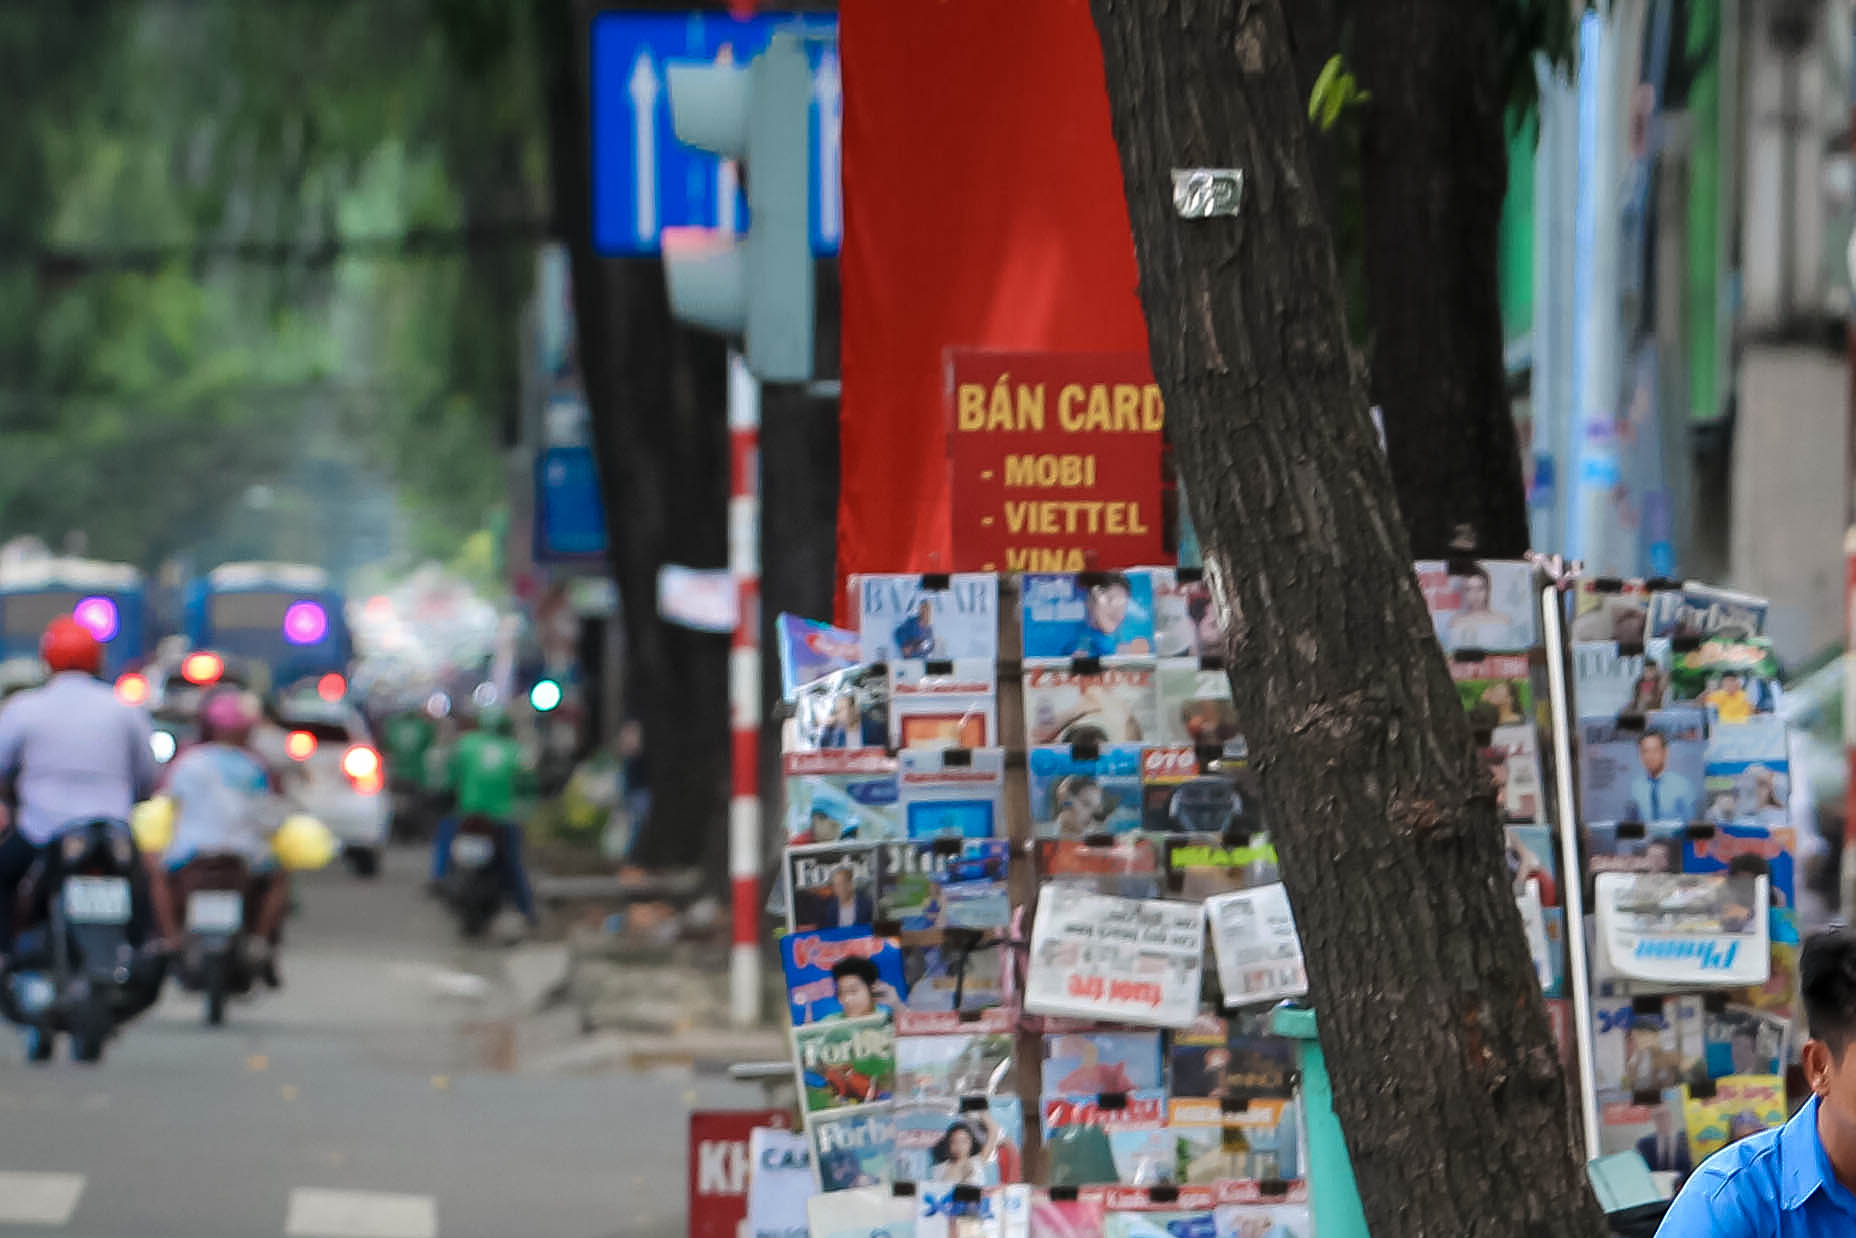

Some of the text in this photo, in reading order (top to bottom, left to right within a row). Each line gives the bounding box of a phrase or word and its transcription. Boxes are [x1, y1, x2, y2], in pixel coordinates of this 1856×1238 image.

[957, 373, 1165, 433] BÁN CARD
[1004, 454, 1096, 487] MOBI
[1004, 501, 1148, 535] VIETTEL
[1006, 548, 1086, 572] VINA
